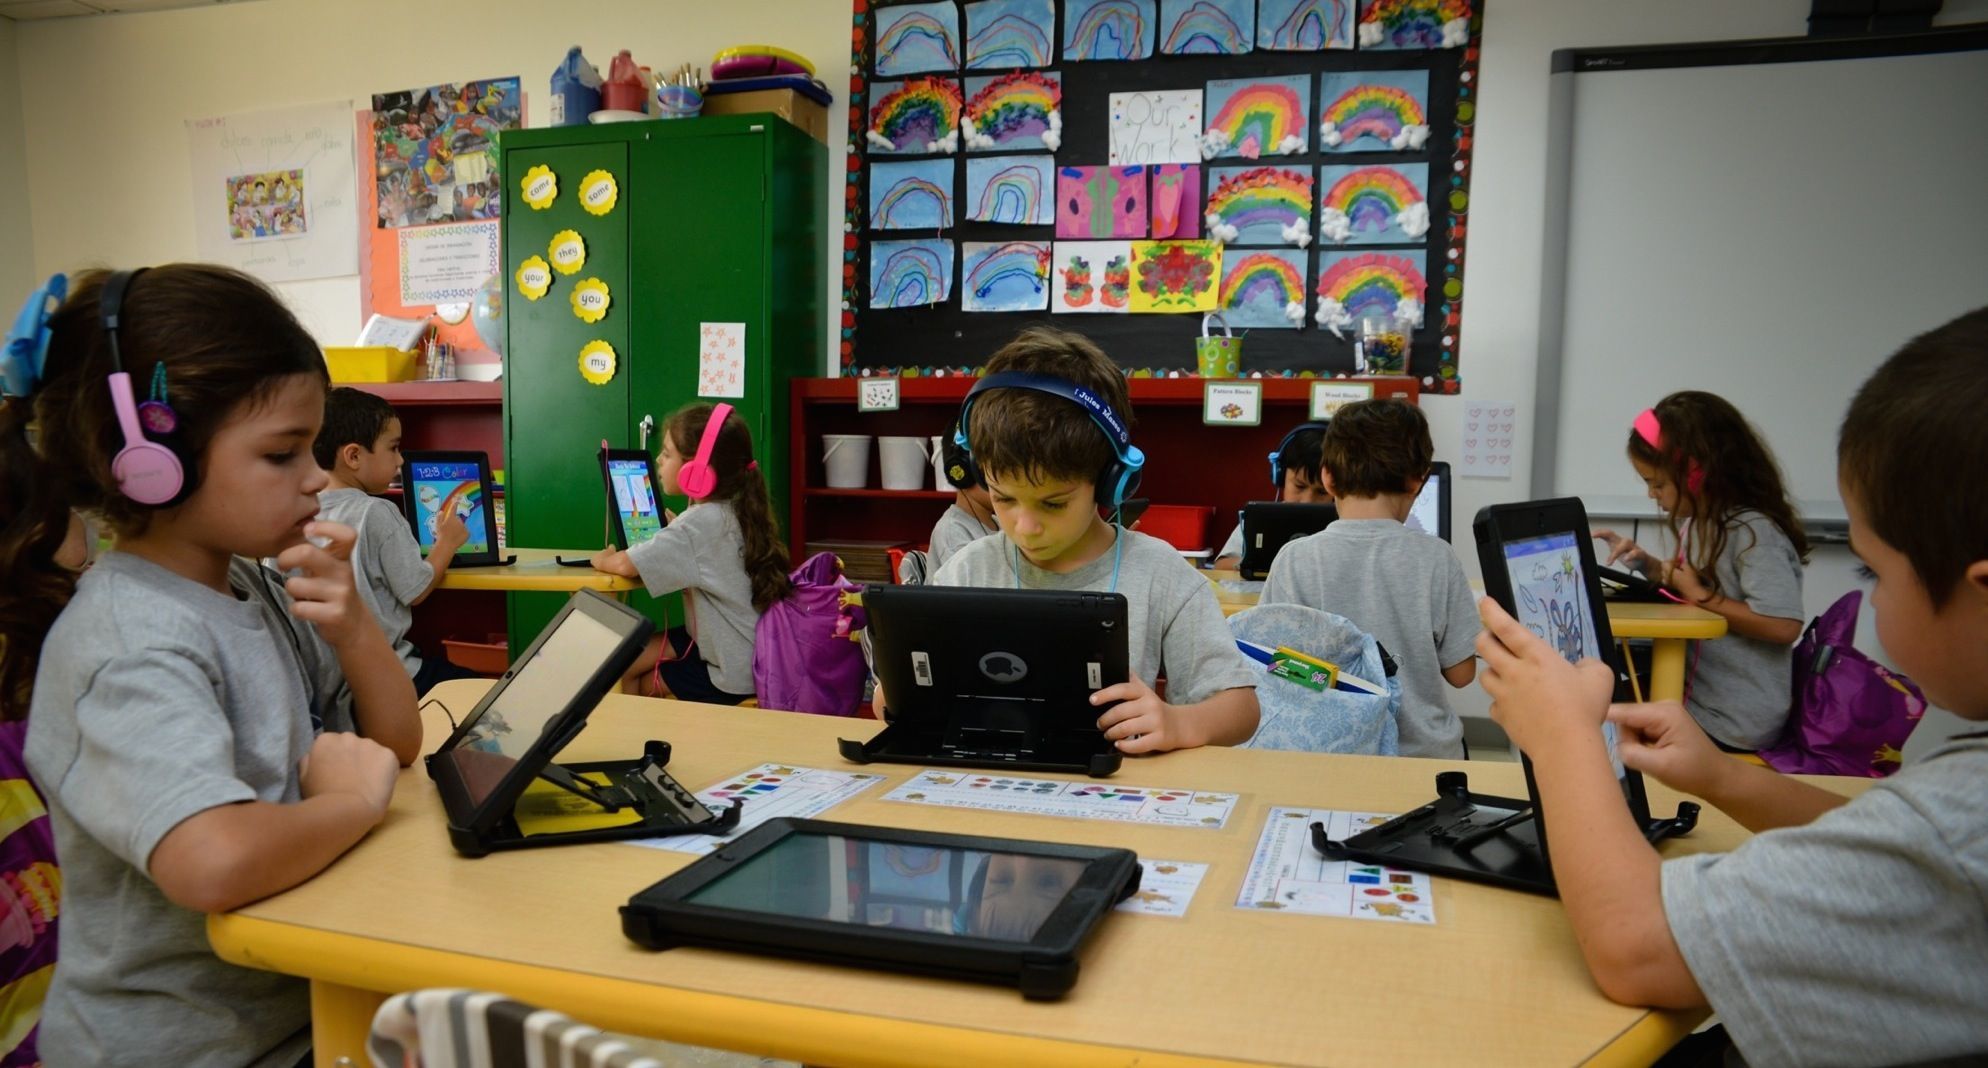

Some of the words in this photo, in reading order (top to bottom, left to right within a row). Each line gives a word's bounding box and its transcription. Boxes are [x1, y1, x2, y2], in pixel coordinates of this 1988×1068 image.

[1127, 93, 1180, 126] Our
[1111, 124, 1179, 164] Work
[530, 179, 550, 197] come
[588, 184, 610, 202] some
[558, 247, 578, 259] they
[524, 273, 544, 284] your
[581, 295, 601, 306] you
[591, 358, 606, 371] my
[1079, 391, 1100, 410] Jules
